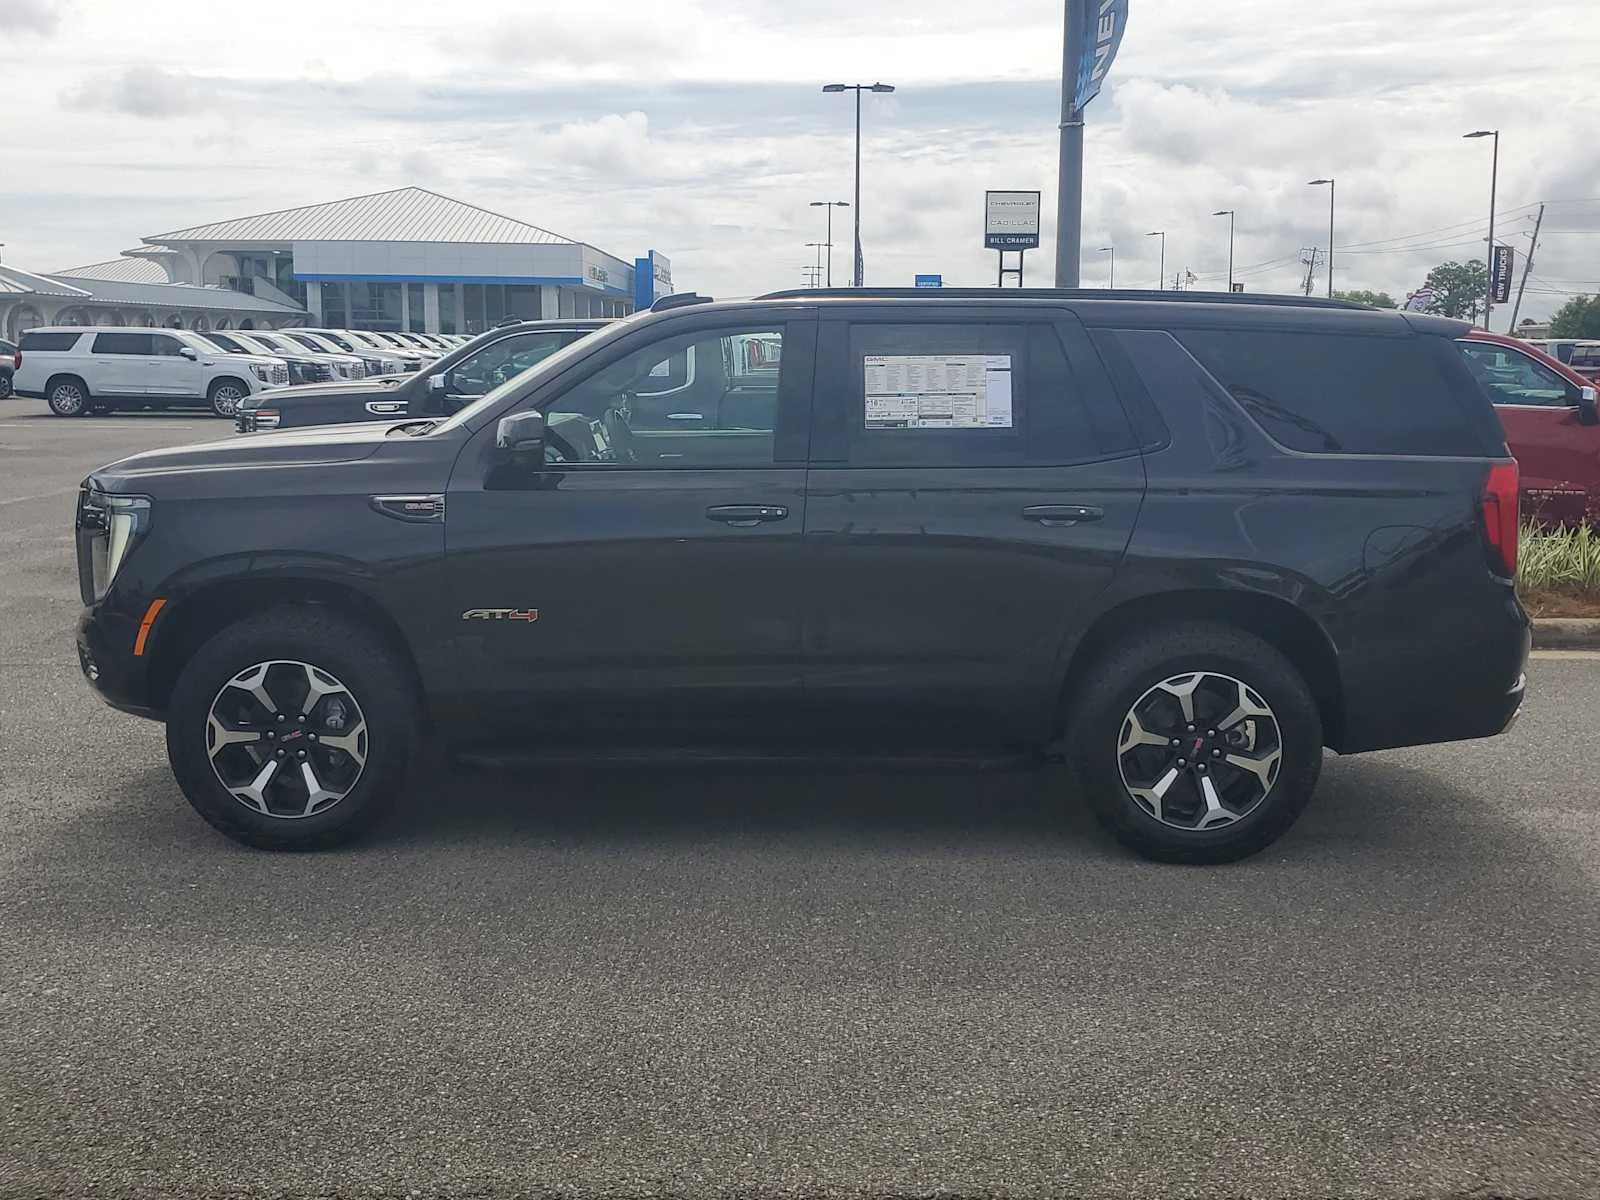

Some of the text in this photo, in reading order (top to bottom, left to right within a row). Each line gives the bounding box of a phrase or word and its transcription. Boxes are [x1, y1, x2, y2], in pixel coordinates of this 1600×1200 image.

[1090, 0, 1115, 81] NE
[1495, 249, 1508, 301] NEW TRUCKS
[404, 502, 434, 510] GMC
[461, 608, 540, 623] AT4
